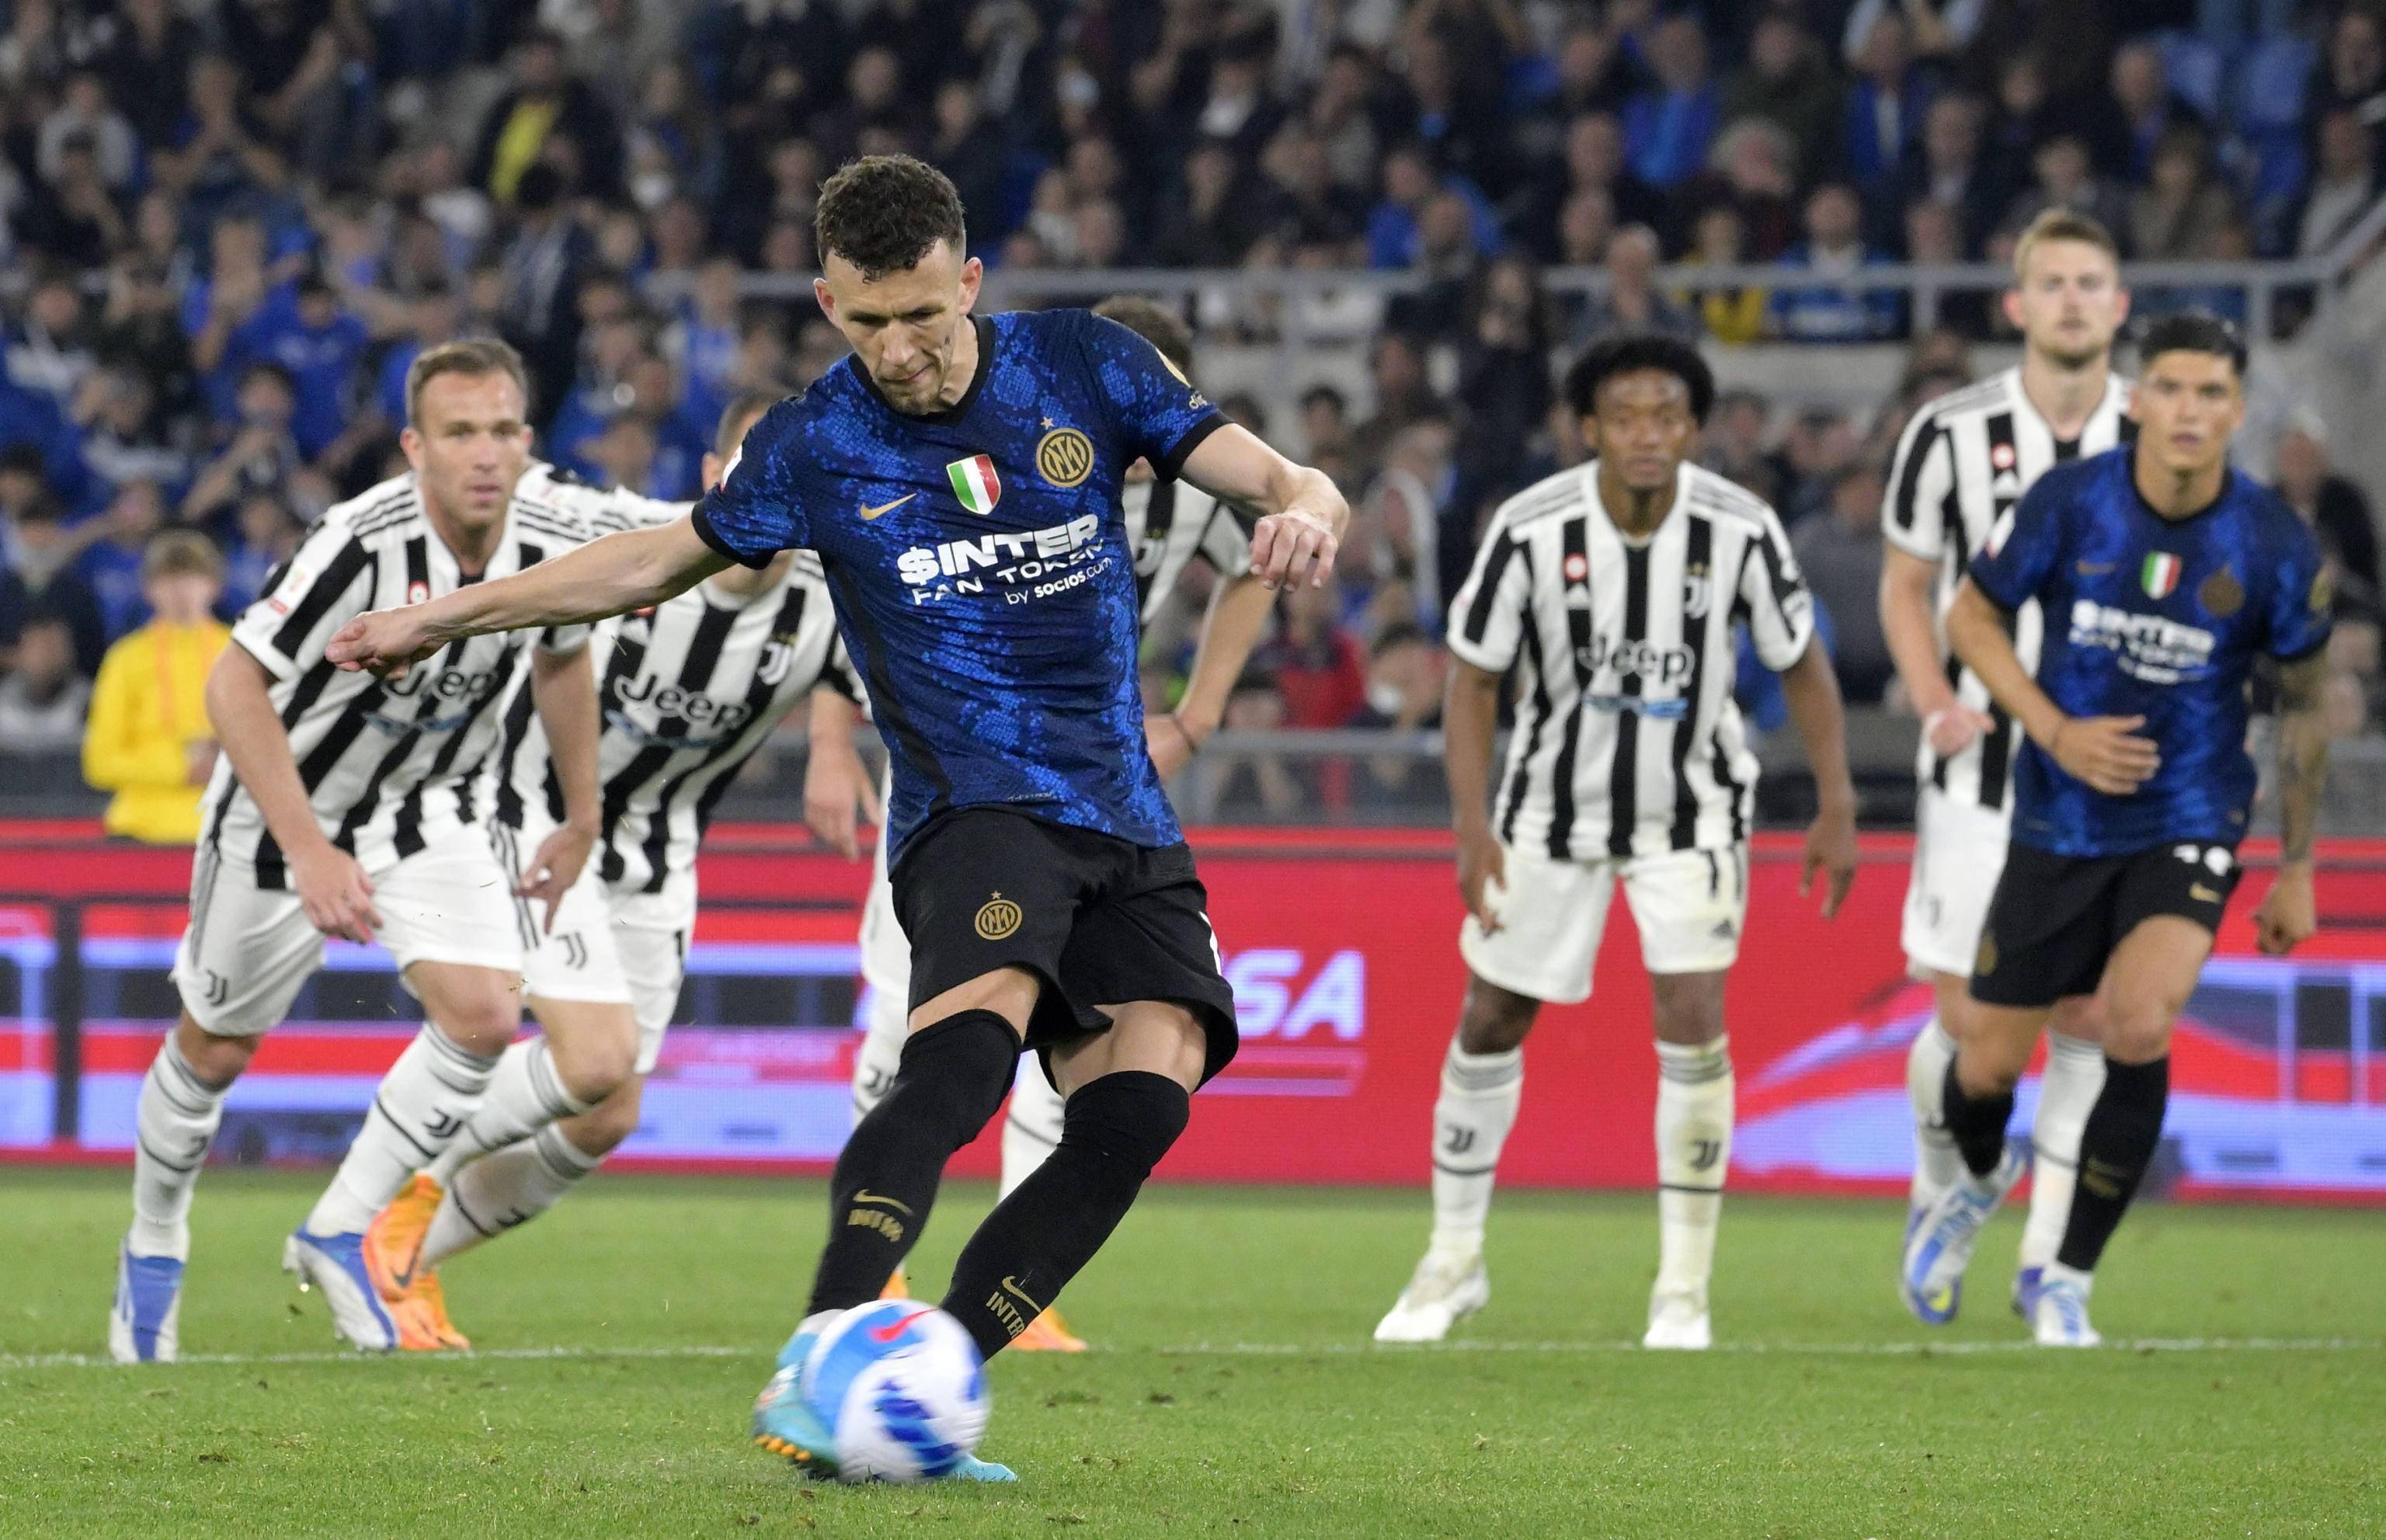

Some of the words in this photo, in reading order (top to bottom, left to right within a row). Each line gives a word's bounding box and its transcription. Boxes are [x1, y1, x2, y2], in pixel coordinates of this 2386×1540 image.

[897, 513, 1099, 586] $INTER
[912, 576, 984, 605] FAN
[1005, 590, 1029, 605] by
[618, 674, 747, 729] Jeep
[1223, 949, 1365, 1041] SA
[986, 1291, 1026, 1340] INTER
